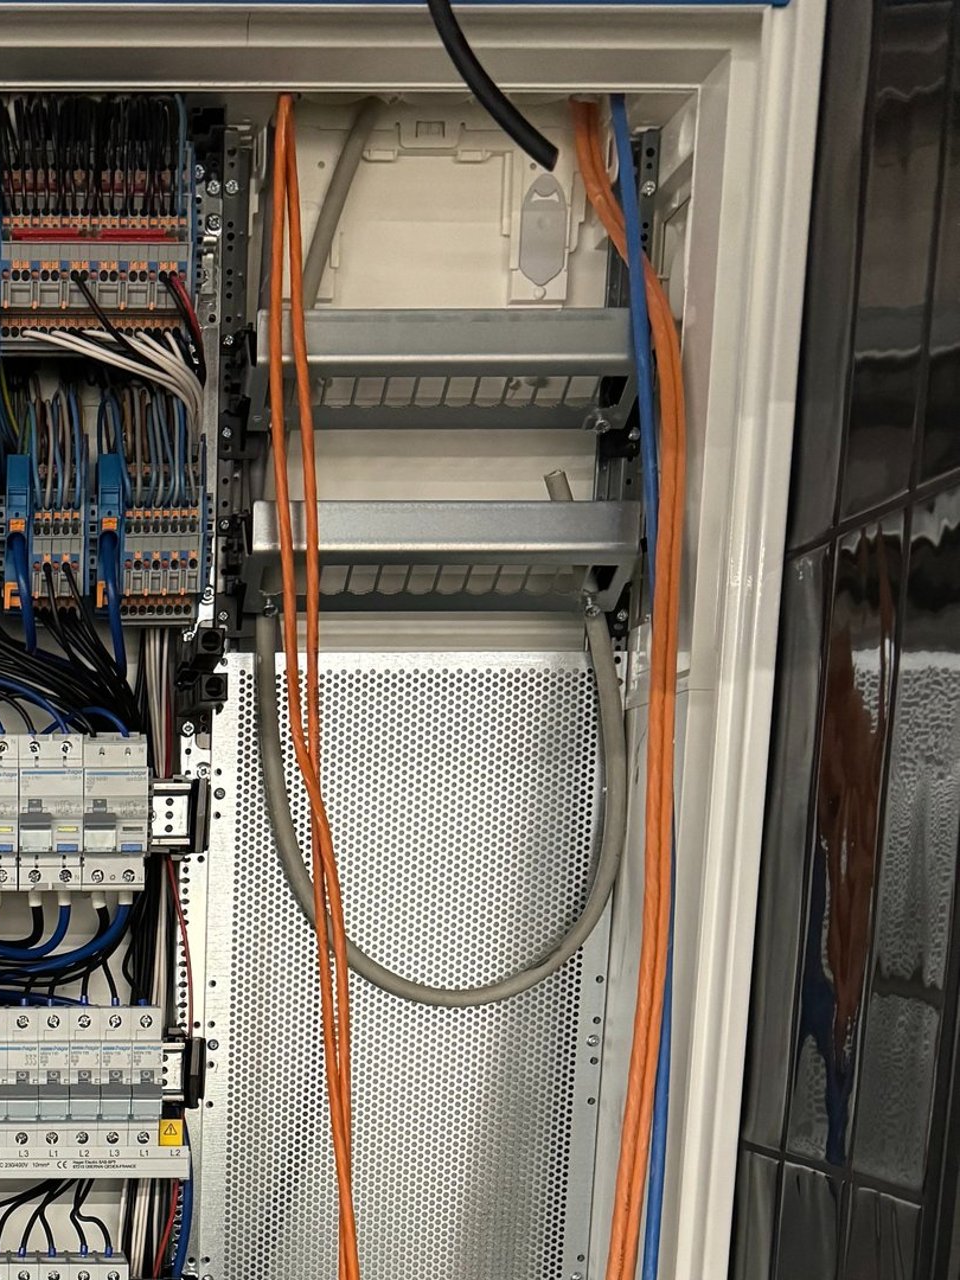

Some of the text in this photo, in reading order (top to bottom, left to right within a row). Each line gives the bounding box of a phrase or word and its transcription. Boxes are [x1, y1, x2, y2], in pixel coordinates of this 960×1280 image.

[18, 1150, 29, 1158] L3
[49, 1150, 58, 1158] L1
[79, 1150, 89, 1158] L2
[109, 1149, 120, 1158] L3
[170, 1149, 180, 1157] L2
